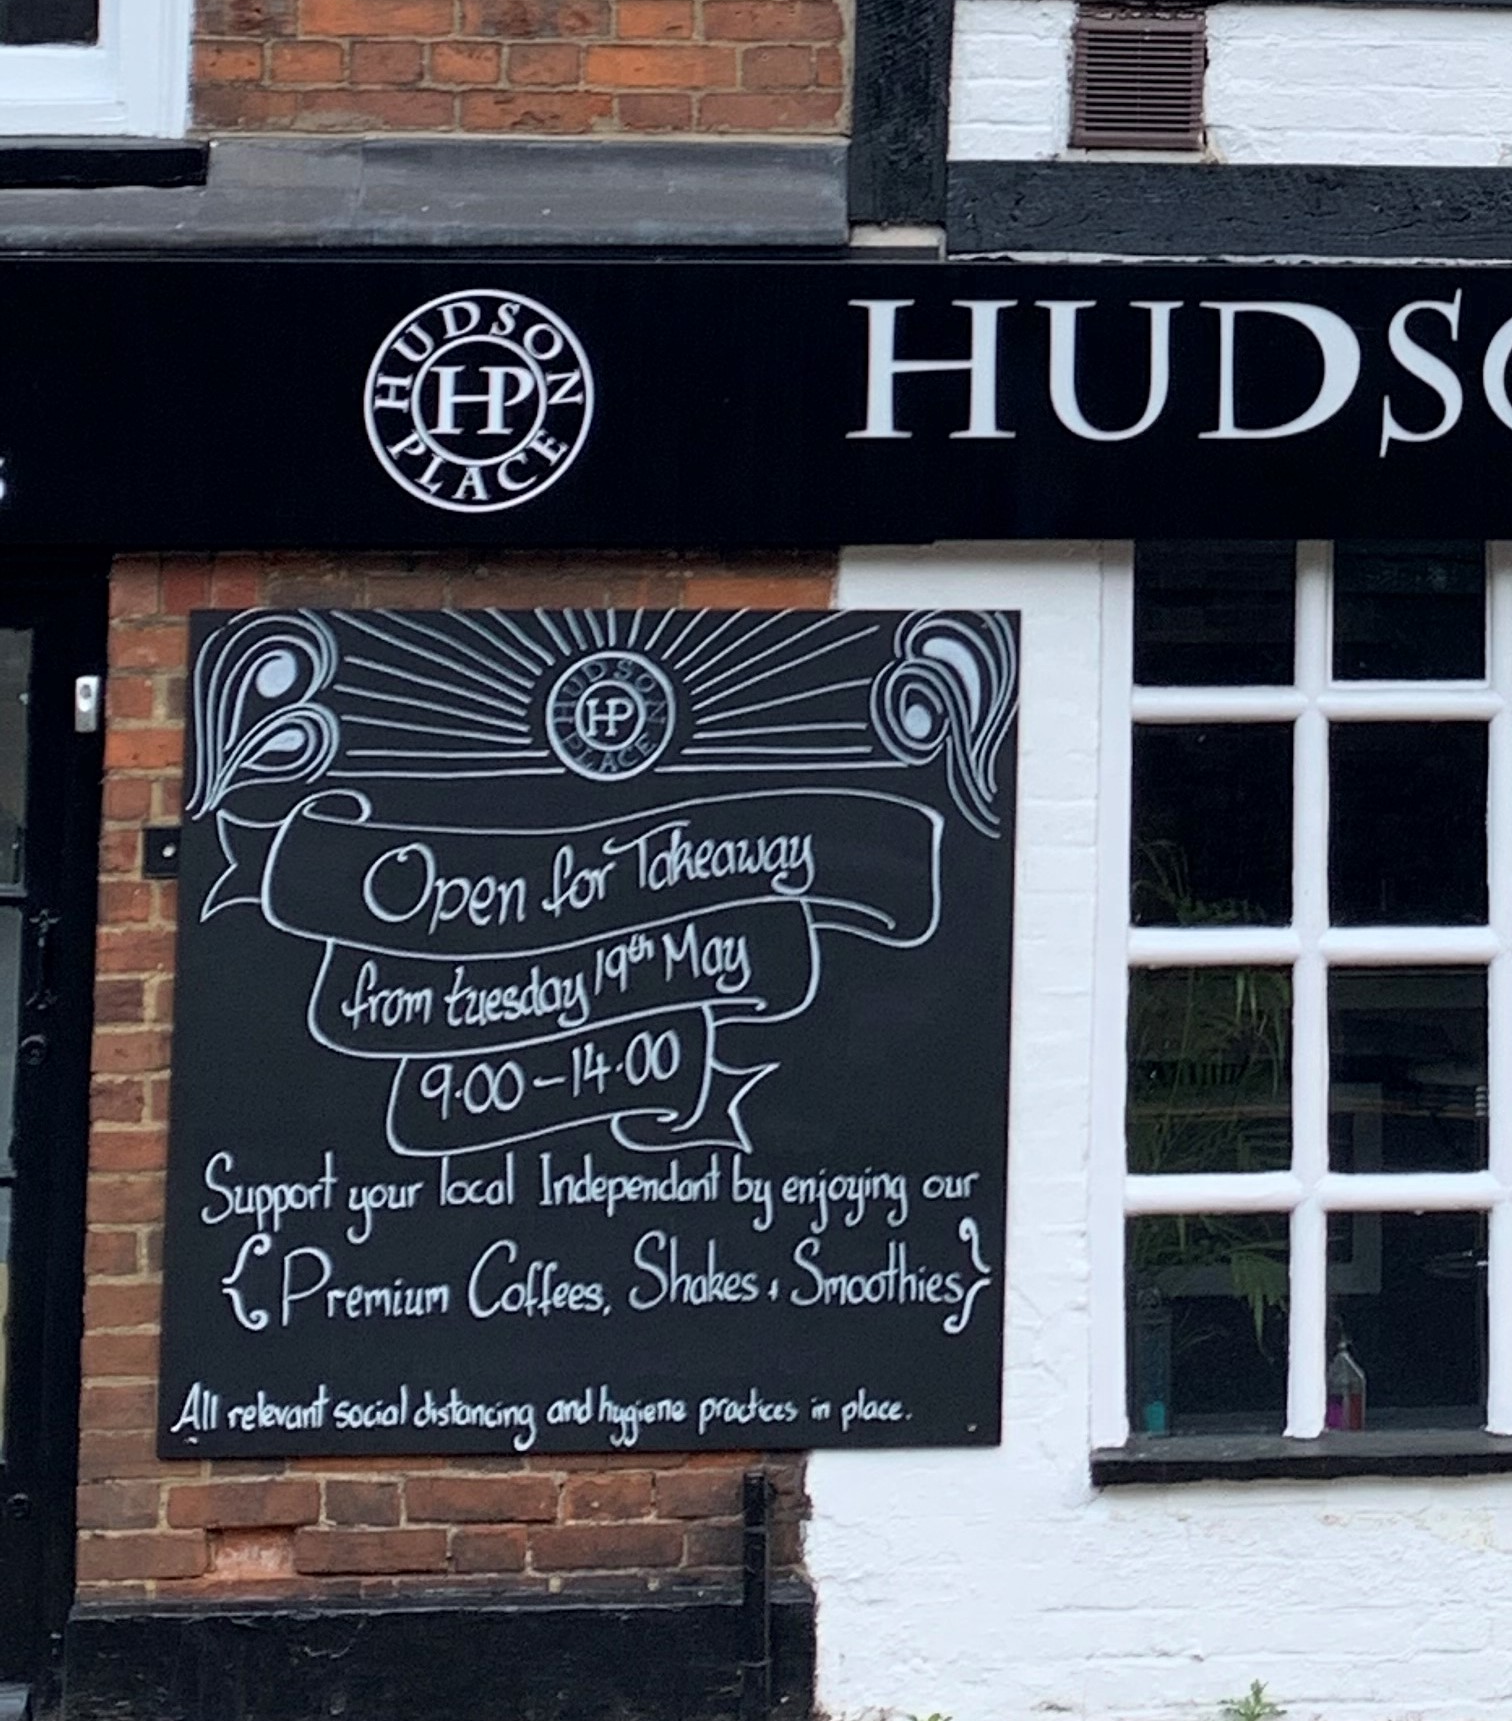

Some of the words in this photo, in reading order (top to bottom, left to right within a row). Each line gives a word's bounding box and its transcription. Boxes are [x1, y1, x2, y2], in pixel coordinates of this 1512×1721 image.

[374, 300, 584, 412] HUDSON
[428, 365, 532, 436] HP
[386, 428, 569, 501] PLACE
[553, 659, 668, 724] HUDSON
[586, 697, 635, 738] HP
[561, 731, 657, 773] PLACE
[362, 841, 526, 936] Open
[541, 845, 616, 918] for
[602, 820, 816, 896] Takeaway
[341, 960, 434, 1030] from
[593, 932, 655, 996] 19th
[661, 922, 753, 994] May
[201, 1151, 339, 1232] Support
[346, 1181, 424, 1244] your
[731, 1152, 773, 1232] by
[781, 1166, 909, 1234] enjoying
[922, 1171, 981, 1201] our
[281, 1246, 450, 1327] Premium
[628, 1229, 760, 1311] Shakes
[790, 1236, 965, 1307] Smoothies
[170, 1381, 220, 1433] All
[227, 1384, 330, 1431] relevant
[332, 1383, 409, 1430] social
[412, 1386, 537, 1452] distancing
[546, 1386, 595, 1426] and
[598, 1384, 688, 1448] hygiene
[698, 1386, 799, 1436] practices
[810, 1396, 832, 1421] in
[842, 1386, 914, 1432] place.
